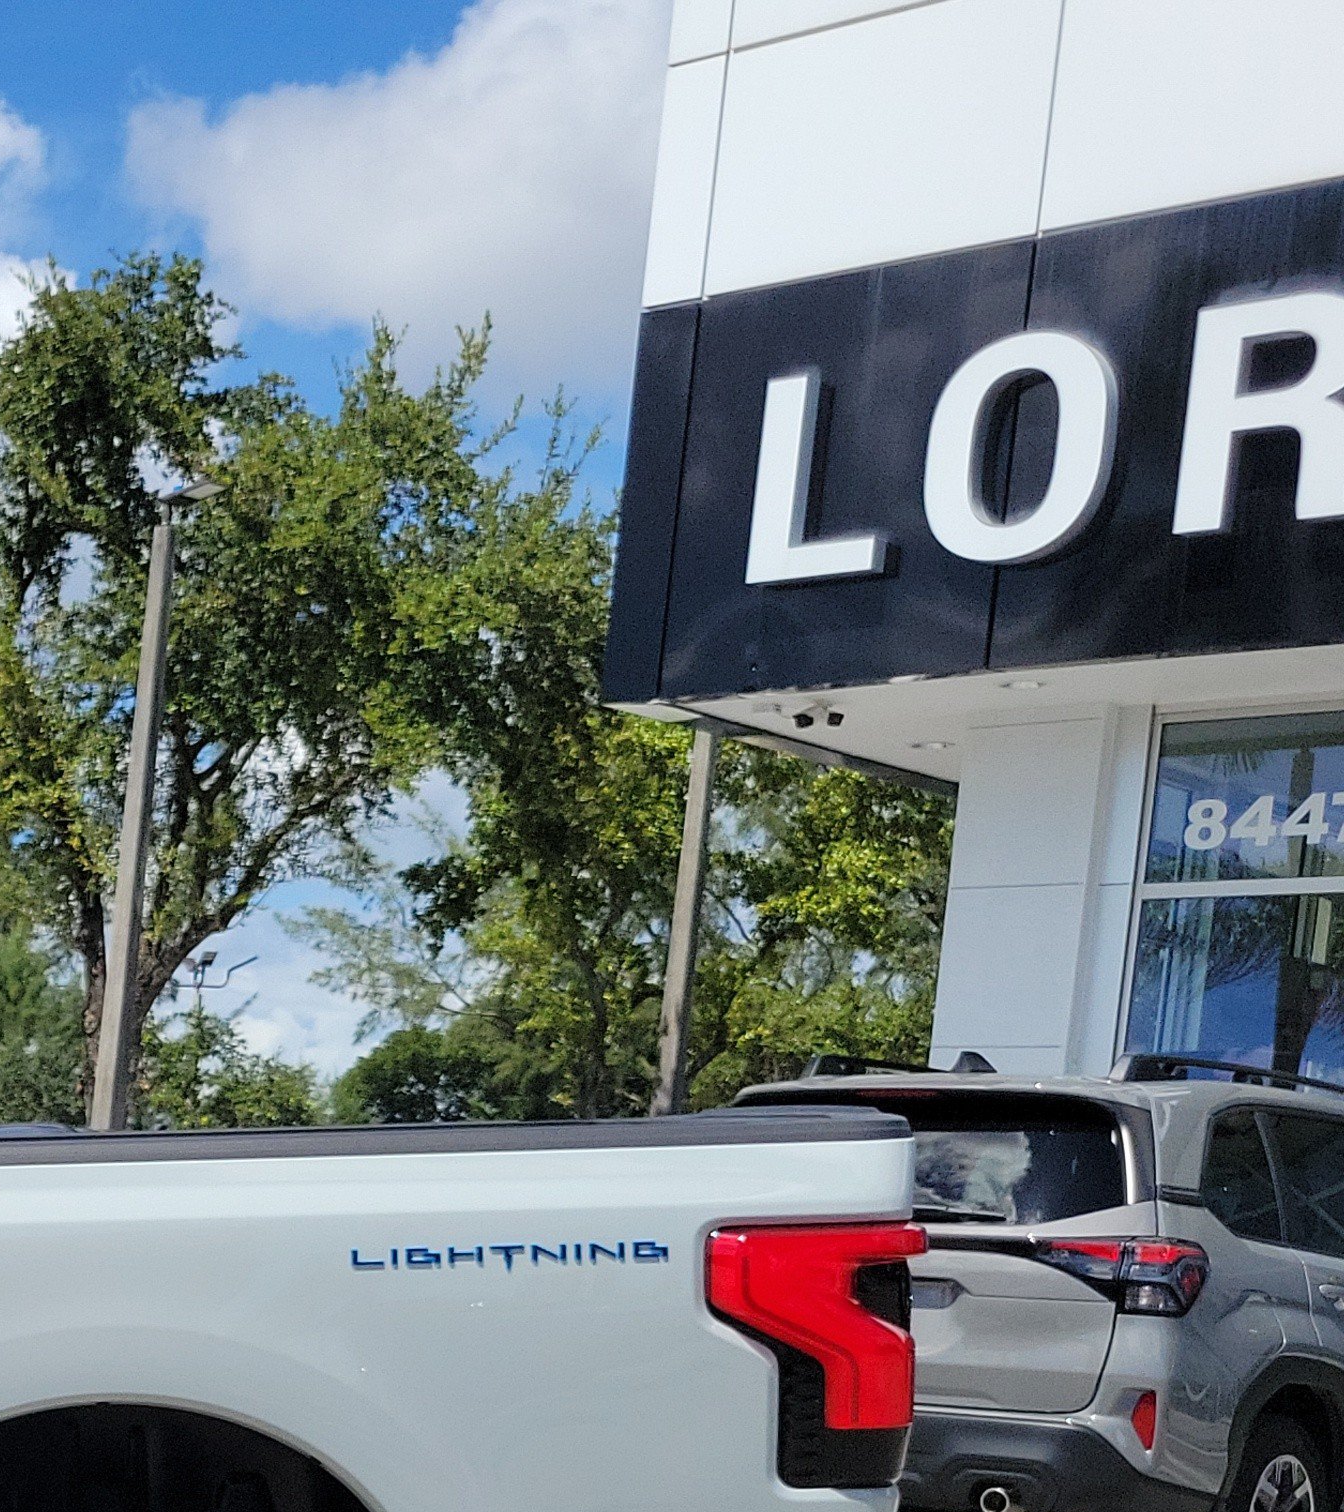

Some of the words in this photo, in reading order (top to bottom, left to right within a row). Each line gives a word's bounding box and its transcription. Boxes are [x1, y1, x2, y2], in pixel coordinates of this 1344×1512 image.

[745, 291, 1344, 585] LOR
[1184, 791, 1344, 850] 844
[350, 1241, 670, 1272] LIGHTNING
